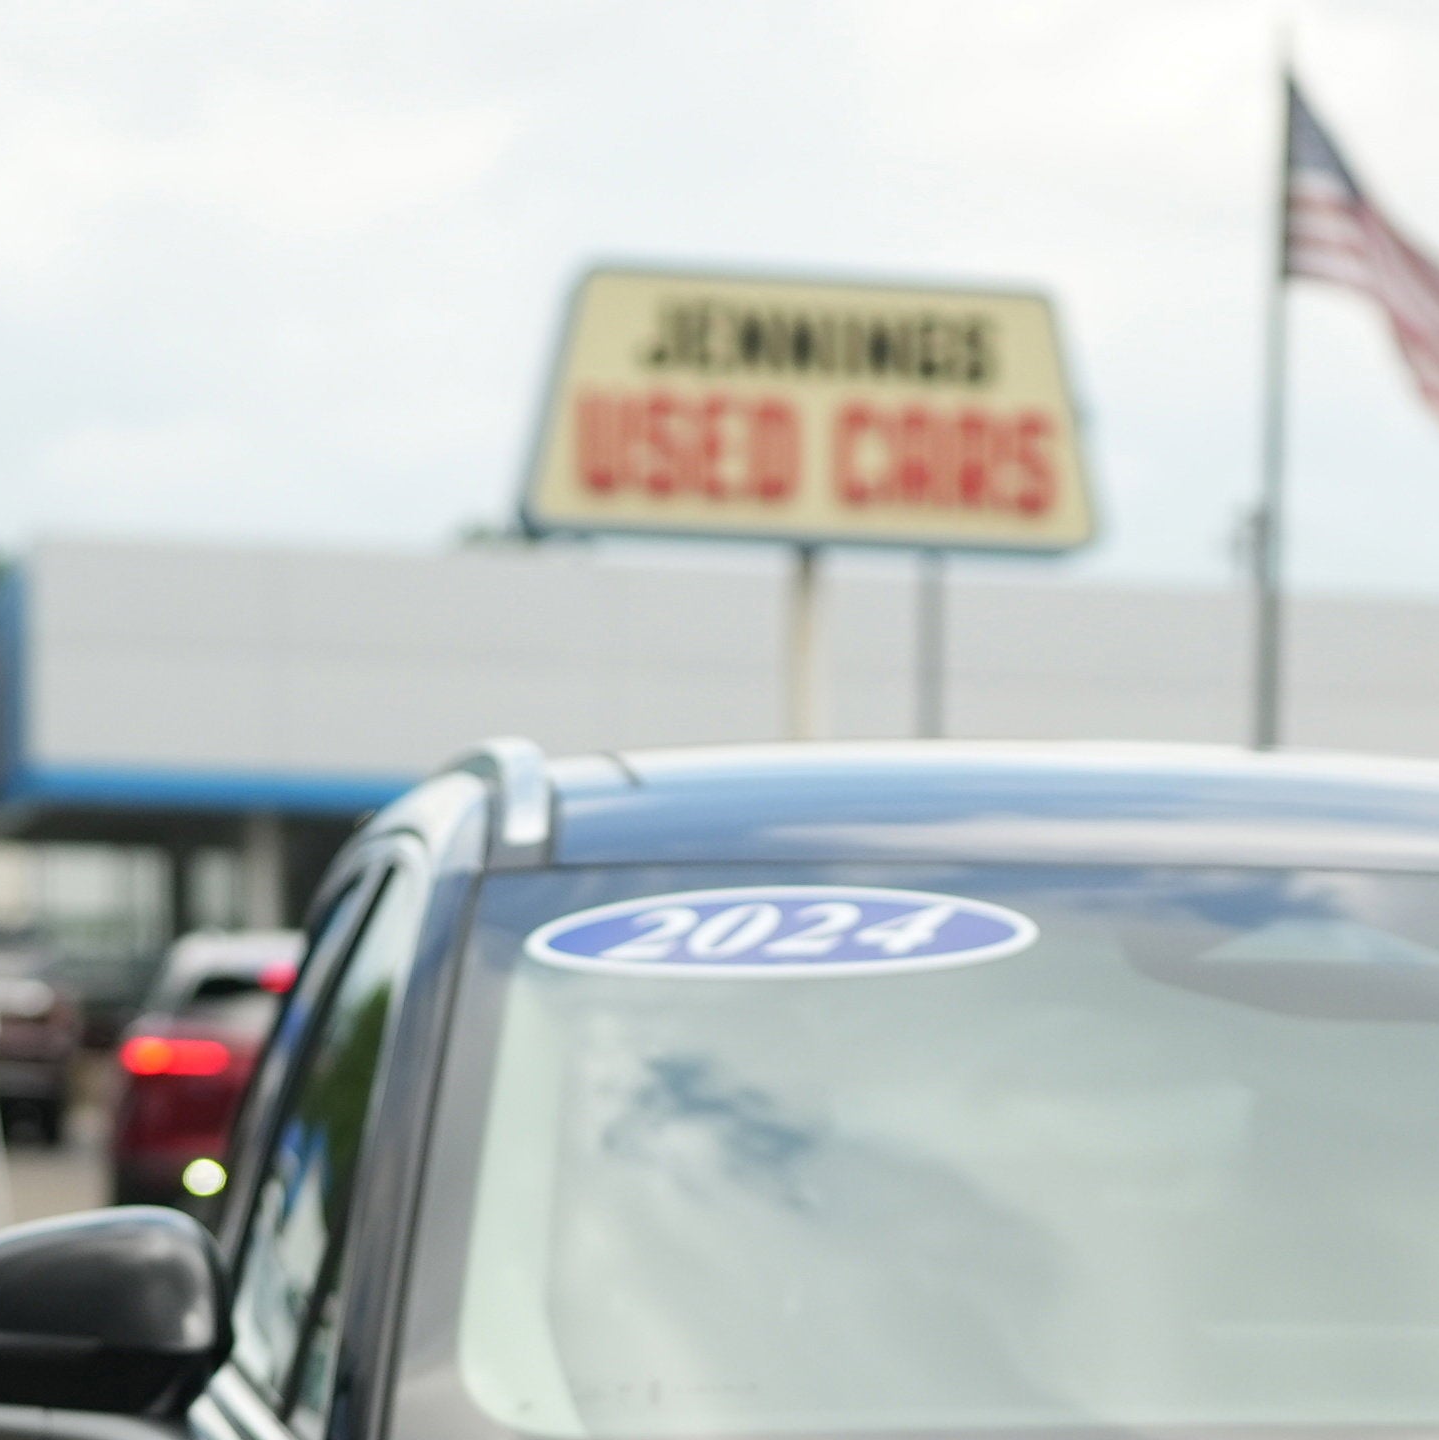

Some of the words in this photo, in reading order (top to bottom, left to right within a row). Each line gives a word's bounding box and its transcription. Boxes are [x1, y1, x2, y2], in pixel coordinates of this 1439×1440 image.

[641, 299, 993, 384] JENNINGS
[575, 388, 800, 500] USED
[838, 401, 1057, 518] CARS
[603, 902, 951, 958] 2024
